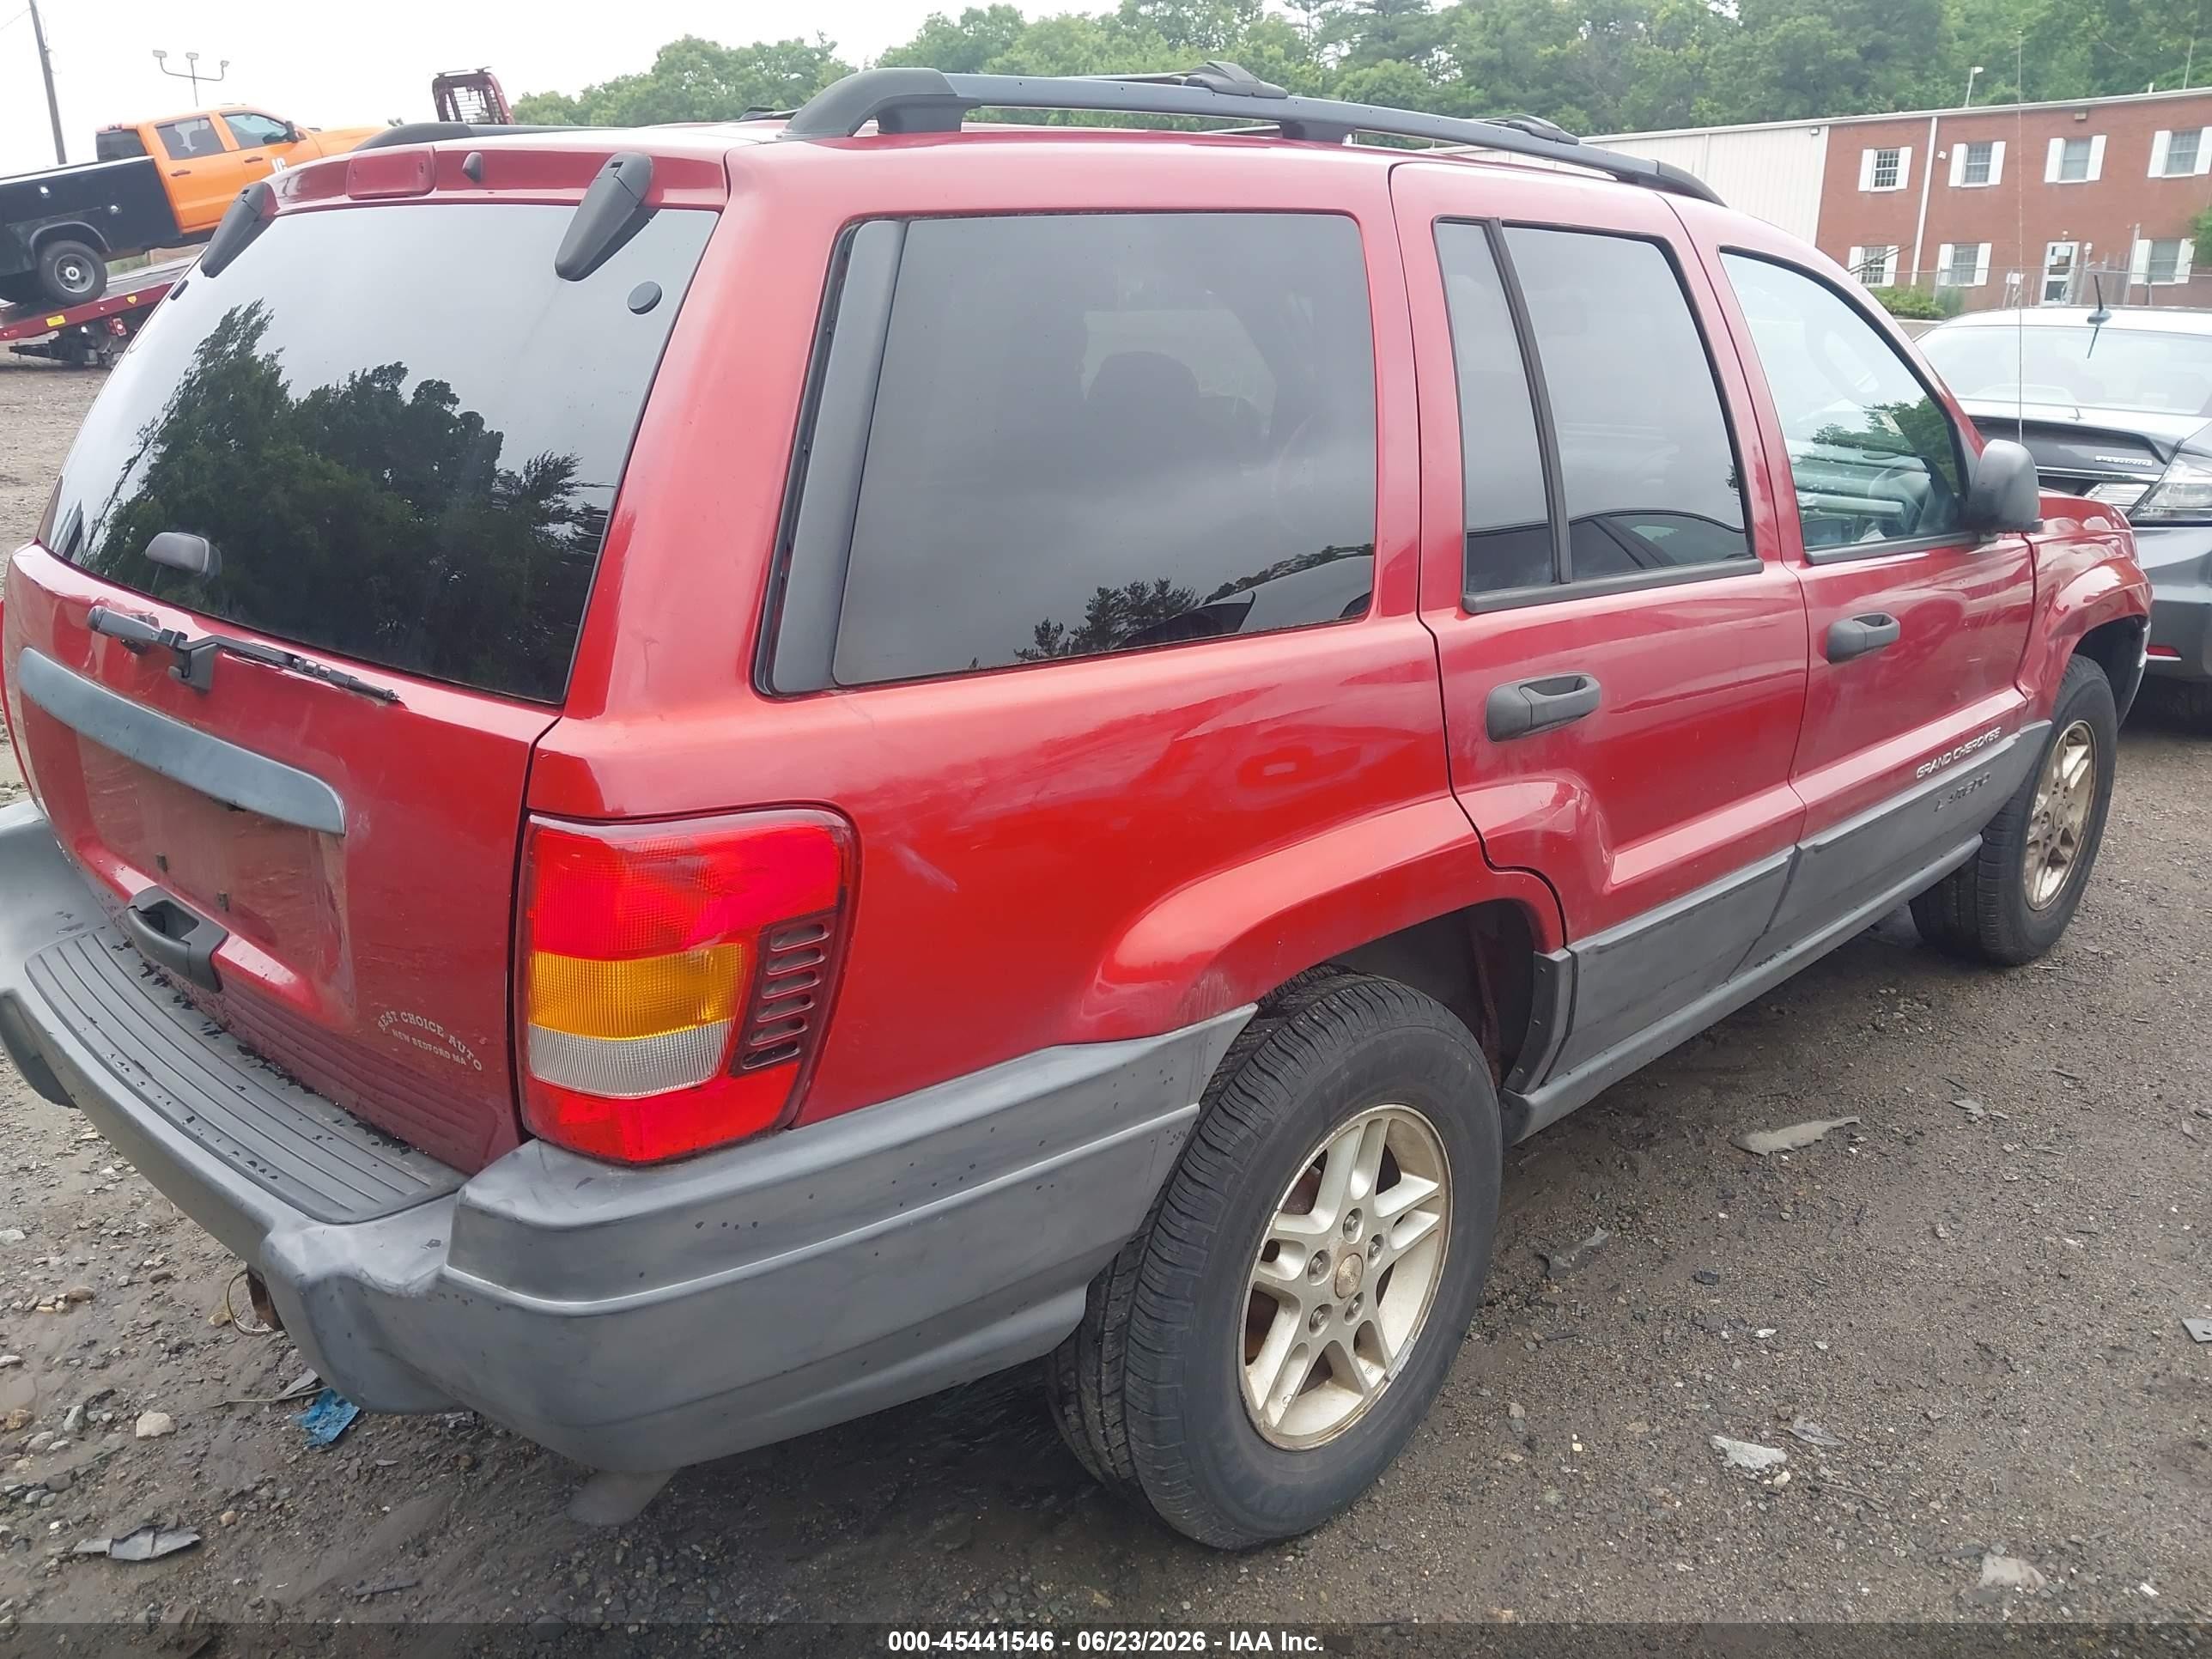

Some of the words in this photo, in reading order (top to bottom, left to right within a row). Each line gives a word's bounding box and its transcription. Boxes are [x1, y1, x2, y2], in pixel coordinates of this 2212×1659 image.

[1916, 751, 1953, 779] GRAND
[1953, 726, 2002, 760] CHEROKEE
[377, 1011, 398, 1032] BEST
[400, 1012, 445, 1038] CHOICE
[448, 1034, 483, 1072] AUTO
[392, 1028, 410, 1042] NEW
[411, 1037, 451, 1060] BEDFORD
[452, 1053, 467, 1065] MA
